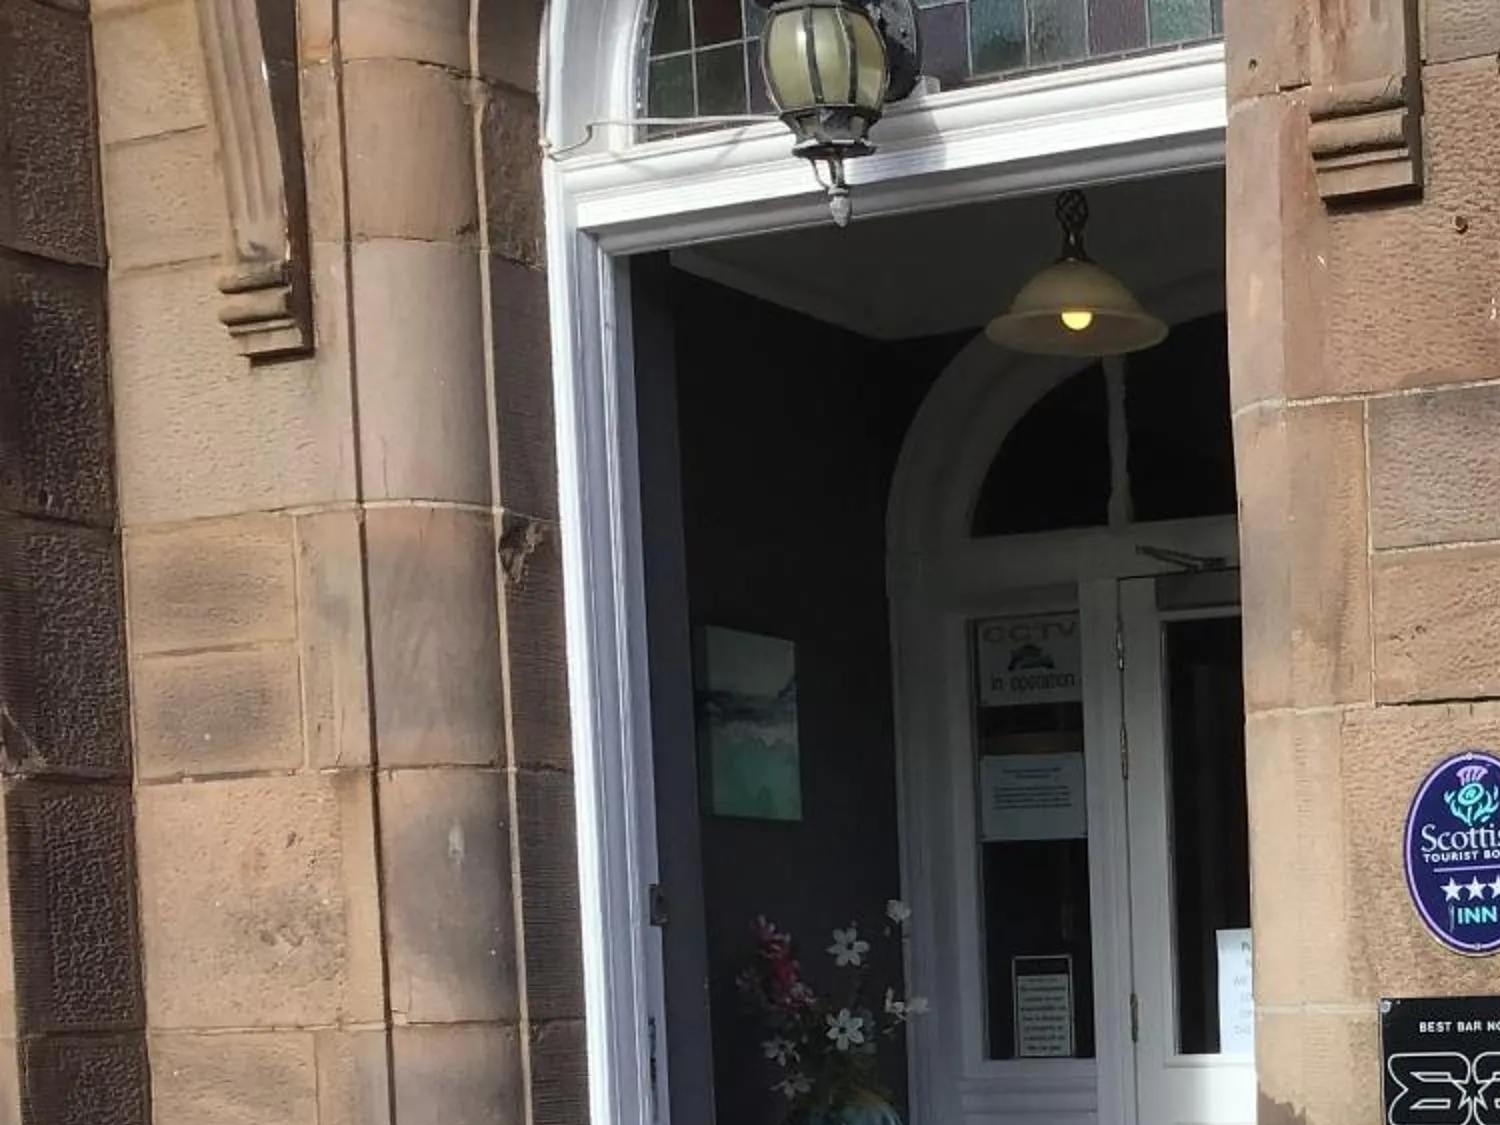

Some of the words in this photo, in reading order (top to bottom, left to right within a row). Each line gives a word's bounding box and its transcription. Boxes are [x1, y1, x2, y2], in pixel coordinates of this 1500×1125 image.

[1424, 850, 1478, 863] TOURIST
[1457, 906, 1498, 924] INN
[1419, 1021, 1452, 1033] BEST
[1457, 1020, 1483, 1032] BAR
